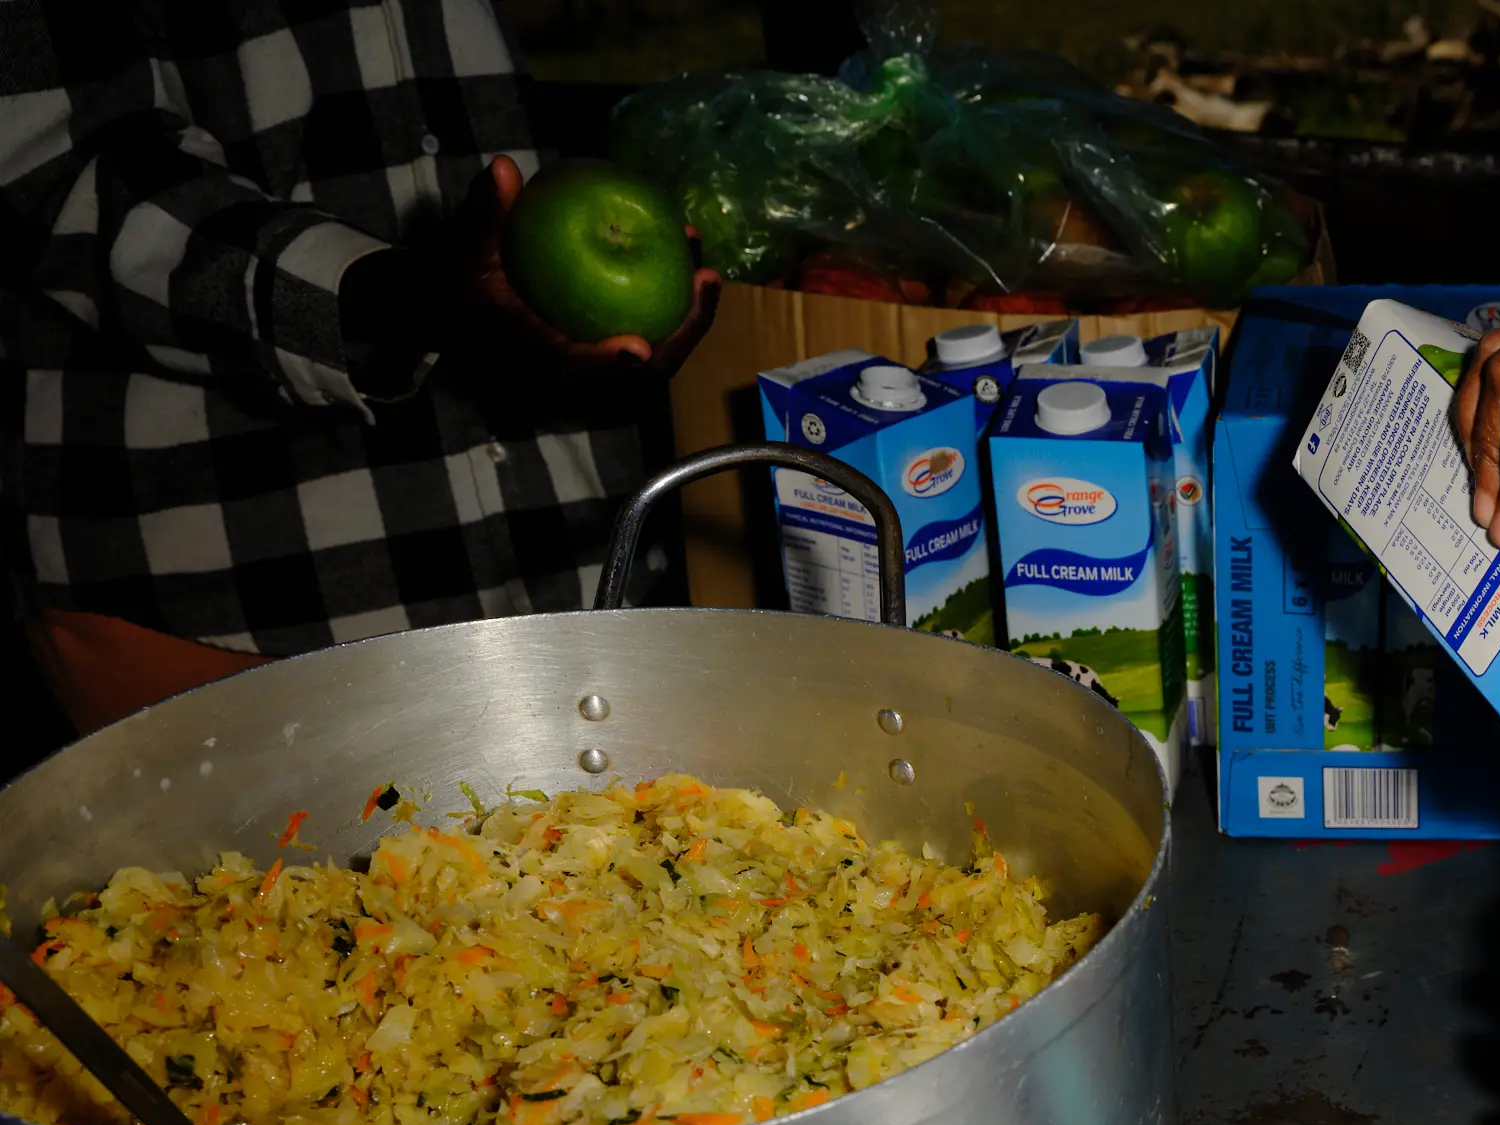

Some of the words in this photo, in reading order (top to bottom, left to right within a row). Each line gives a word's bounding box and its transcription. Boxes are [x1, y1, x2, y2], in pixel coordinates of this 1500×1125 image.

[1350, 360, 1367, 393] Product
[1388, 357, 1421, 422] REFRIGERATED
[1365, 380, 1383, 416] Wasbank
[1372, 377, 1391, 416] ORANGE
[1412, 382, 1426, 408] BEST
[1335, 400, 1348, 426] South
[1408, 406, 1415, 417] IF
[1413, 393, 1429, 426] STORE
[1325, 423, 1338, 446] Africa
[1355, 415, 1367, 437] Road
[1358, 415, 1374, 447] GROVE
[1359, 389, 1393, 458] MANUFACTURED
[1379, 421, 1391, 441] AND
[1385, 421, 1400, 447] ONCE
[1409, 425, 1416, 436] IN
[1341, 436, 1357, 467] Dundee
[1371, 439, 1382, 459] USE
[1378, 416, 1411, 483] REFRIGERATED
[1405, 435, 1412, 444] A
[1346, 445, 1360, 472] DAIRY
[1354, 457, 1362, 471] BY
[1394, 443, 1408, 469] COOL
[1358, 456, 1374, 487] WITHIN
[1385, 468, 1396, 488] DRY
[1396, 462, 1410, 489] COW'S
[1407, 461, 1419, 482] FULL
[1356, 483, 1369, 508] KEEP
[1360, 480, 1380, 517] BEFORE
[1386, 488, 1397, 508] MILK
[1393, 480, 1409, 510] CREAM
[1383, 508, 1395, 528] MILK
[905, 543, 927, 563] FULL
[928, 528, 958, 554] CREAM
[958, 519, 978, 539] MILK
[1230, 535, 1252, 592] MILK
[1469, 550, 1478, 565] 100
[1017, 563, 1049, 578] FULL
[1052, 565, 1098, 580] CREAM
[1101, 567, 1133, 580] MILK
[1330, 569, 1364, 585] MILK
[1292, 595, 1307, 607] 6
[1430, 581, 1450, 613] Serving)
[1438, 586, 1455, 614] (Single
[1450, 592, 1460, 607] 250
[1453, 581, 1490, 639] INFORMATION
[1456, 599, 1465, 612] Per
[1230, 598, 1252, 676] CREAM
[1264, 659, 1275, 709] PROCESS
[1233, 681, 1252, 732] FULL
[1264, 712, 1275, 733] UHT
